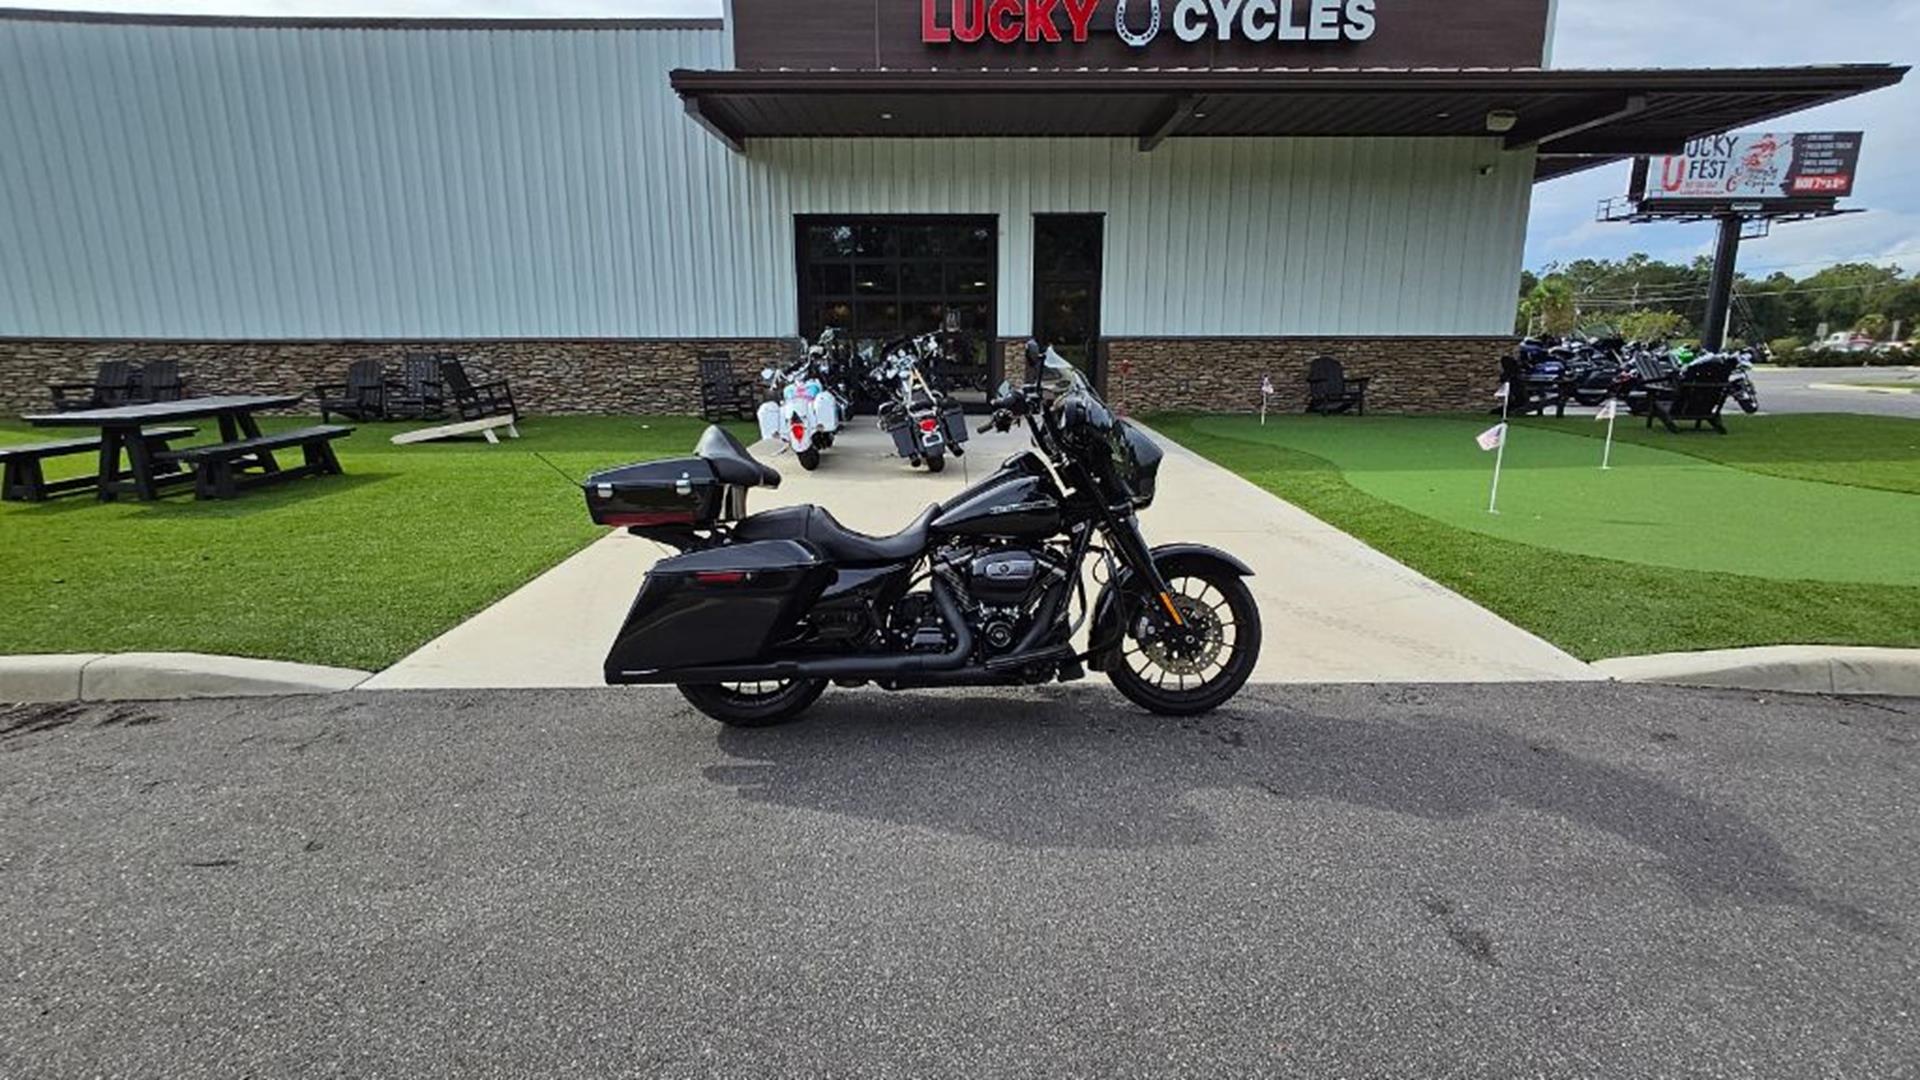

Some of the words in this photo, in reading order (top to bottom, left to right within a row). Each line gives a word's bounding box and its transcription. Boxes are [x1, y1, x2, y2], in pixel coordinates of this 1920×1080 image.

[921, 0, 1097, 42] LUCKY
[1173, 0, 1376, 41] CYCLES
[1687, 136, 1739, 158] UCKY
[1688, 160, 1727, 179] FEST
